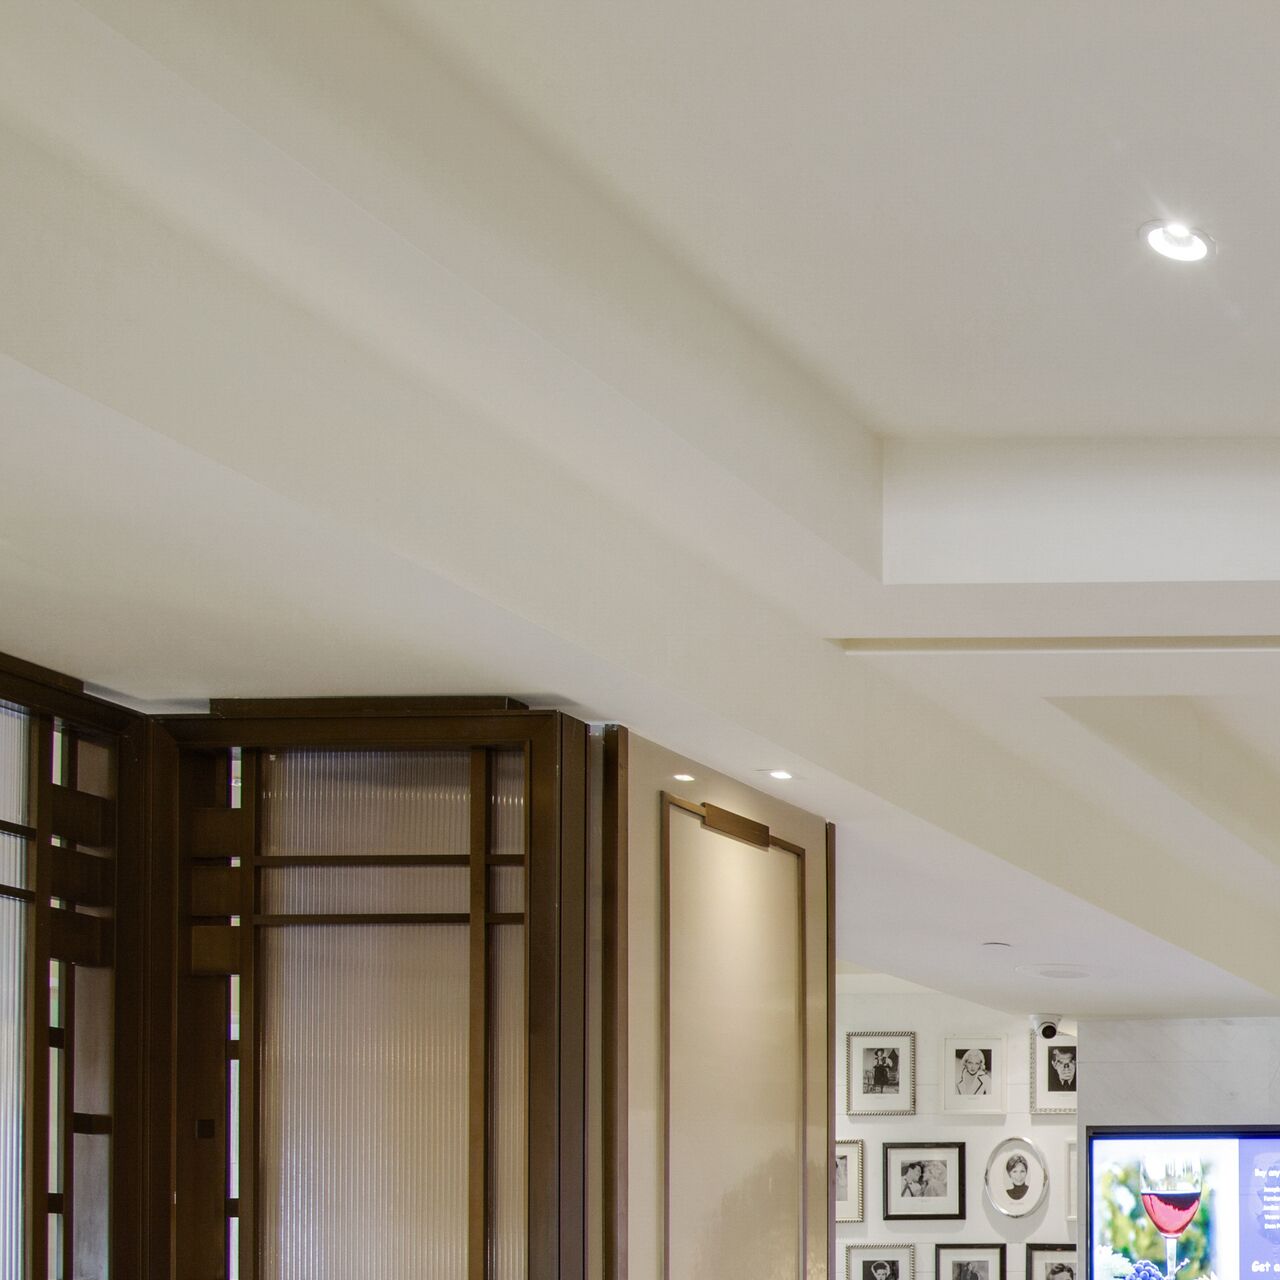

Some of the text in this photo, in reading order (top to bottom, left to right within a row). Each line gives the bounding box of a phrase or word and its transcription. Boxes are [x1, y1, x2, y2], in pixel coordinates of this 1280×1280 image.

[1268, 1170, 1280, 1178] any
[1251, 1260, 1271, 1272] Get
[1273, 1263, 1280, 1272] a
